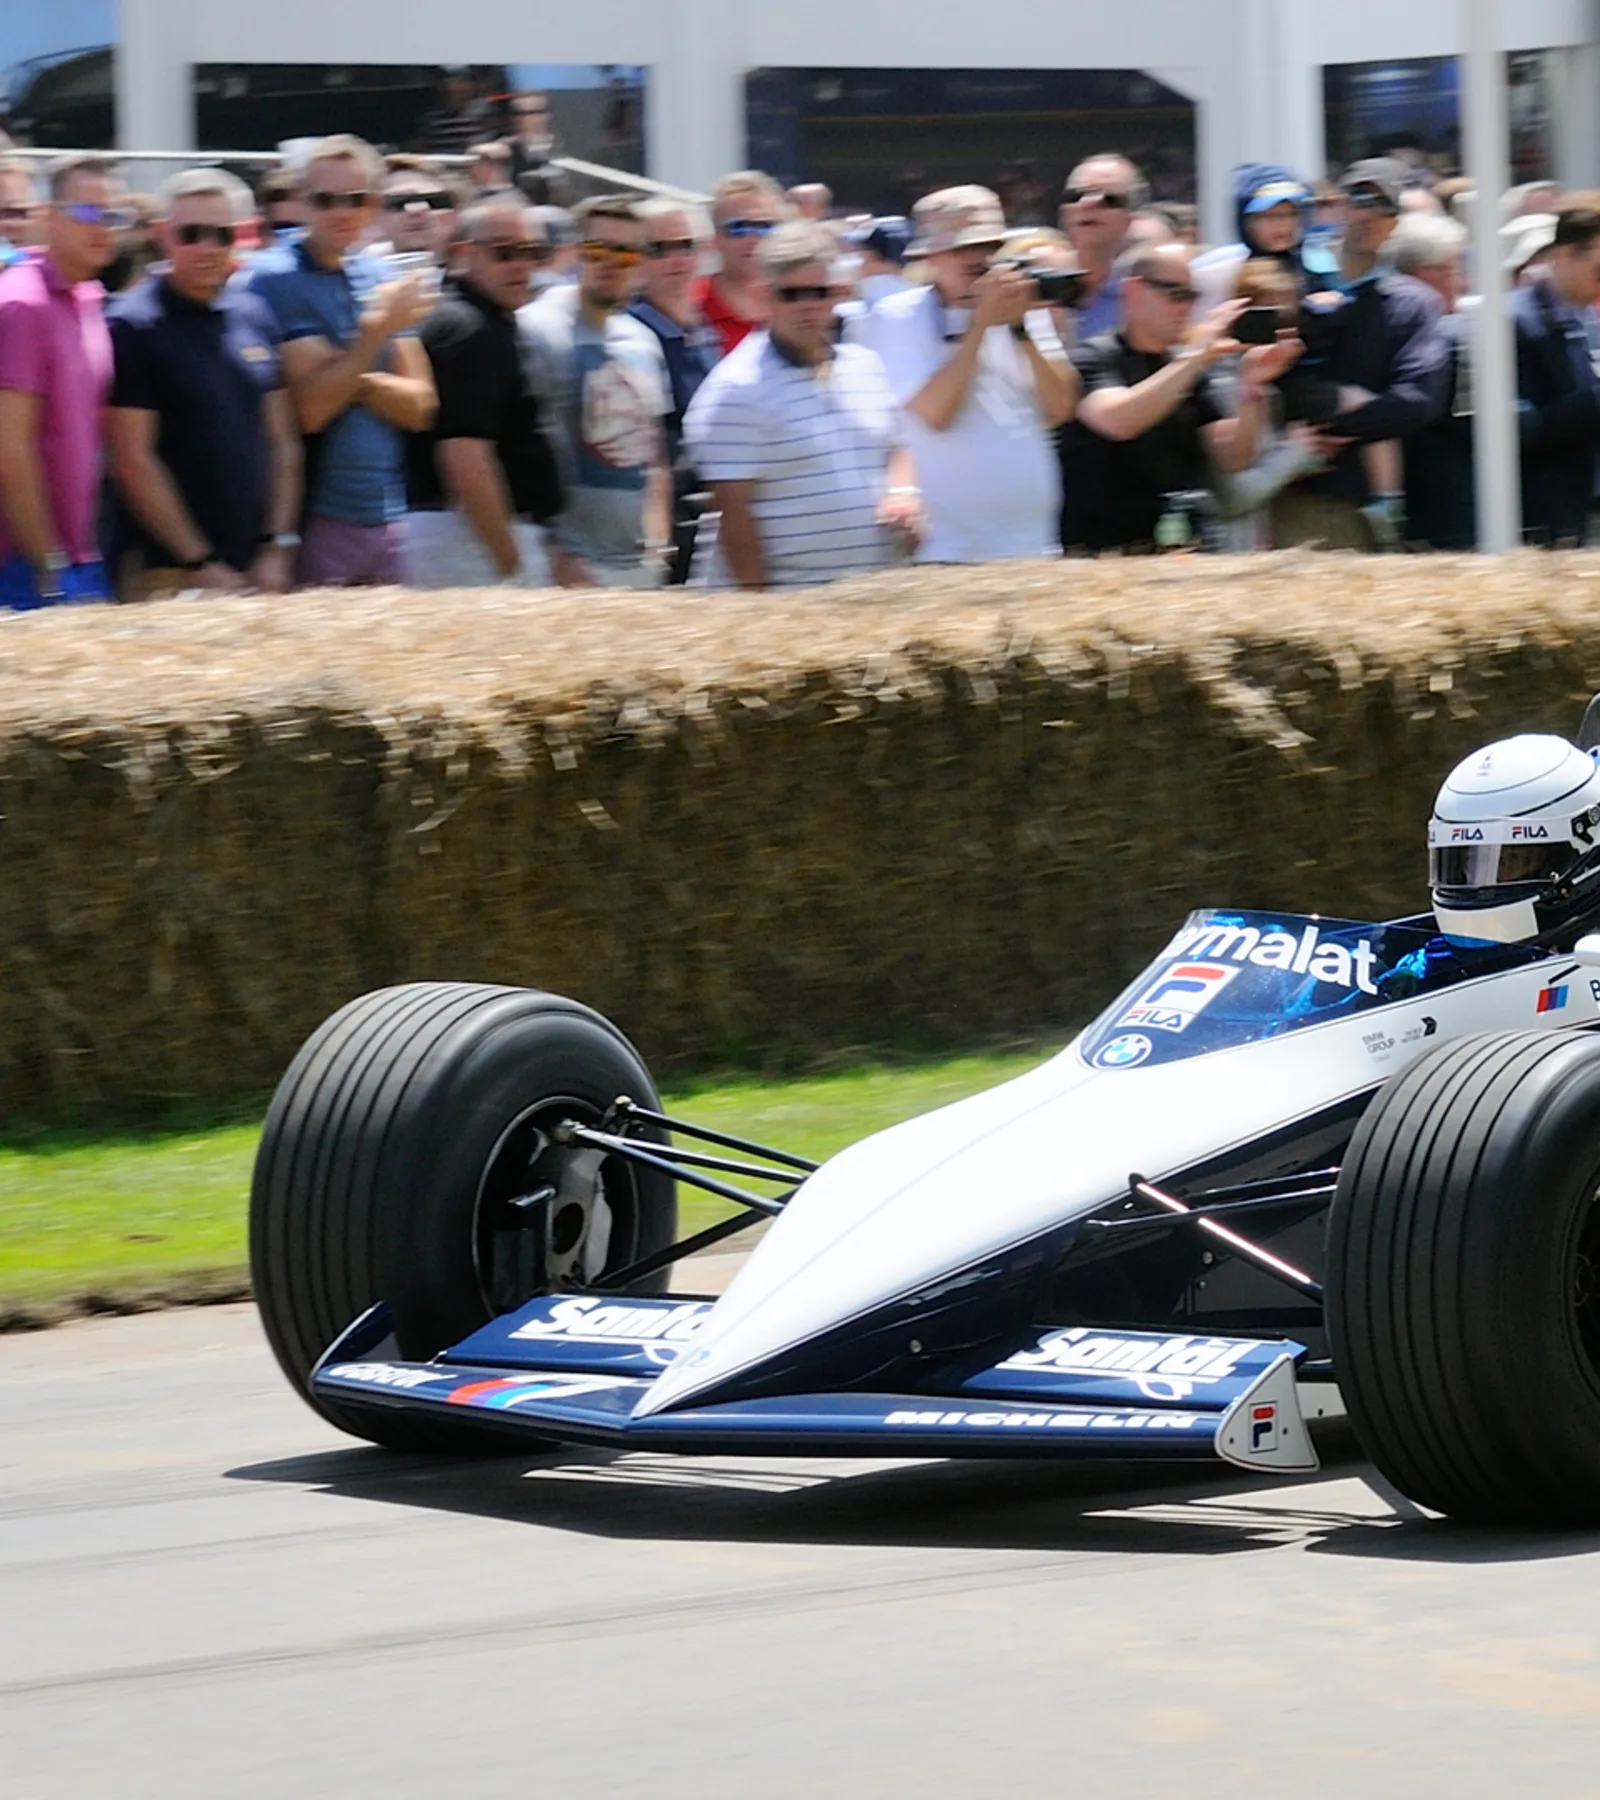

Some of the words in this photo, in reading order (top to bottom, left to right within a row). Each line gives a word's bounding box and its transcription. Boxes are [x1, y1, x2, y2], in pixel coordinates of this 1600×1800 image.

[1451, 828, 1484, 841] FILA
[1512, 825, 1549, 839] FILA
[1121, 1010, 1183, 1029] FILA
[883, 1409, 1199, 1430] MICHELIN
